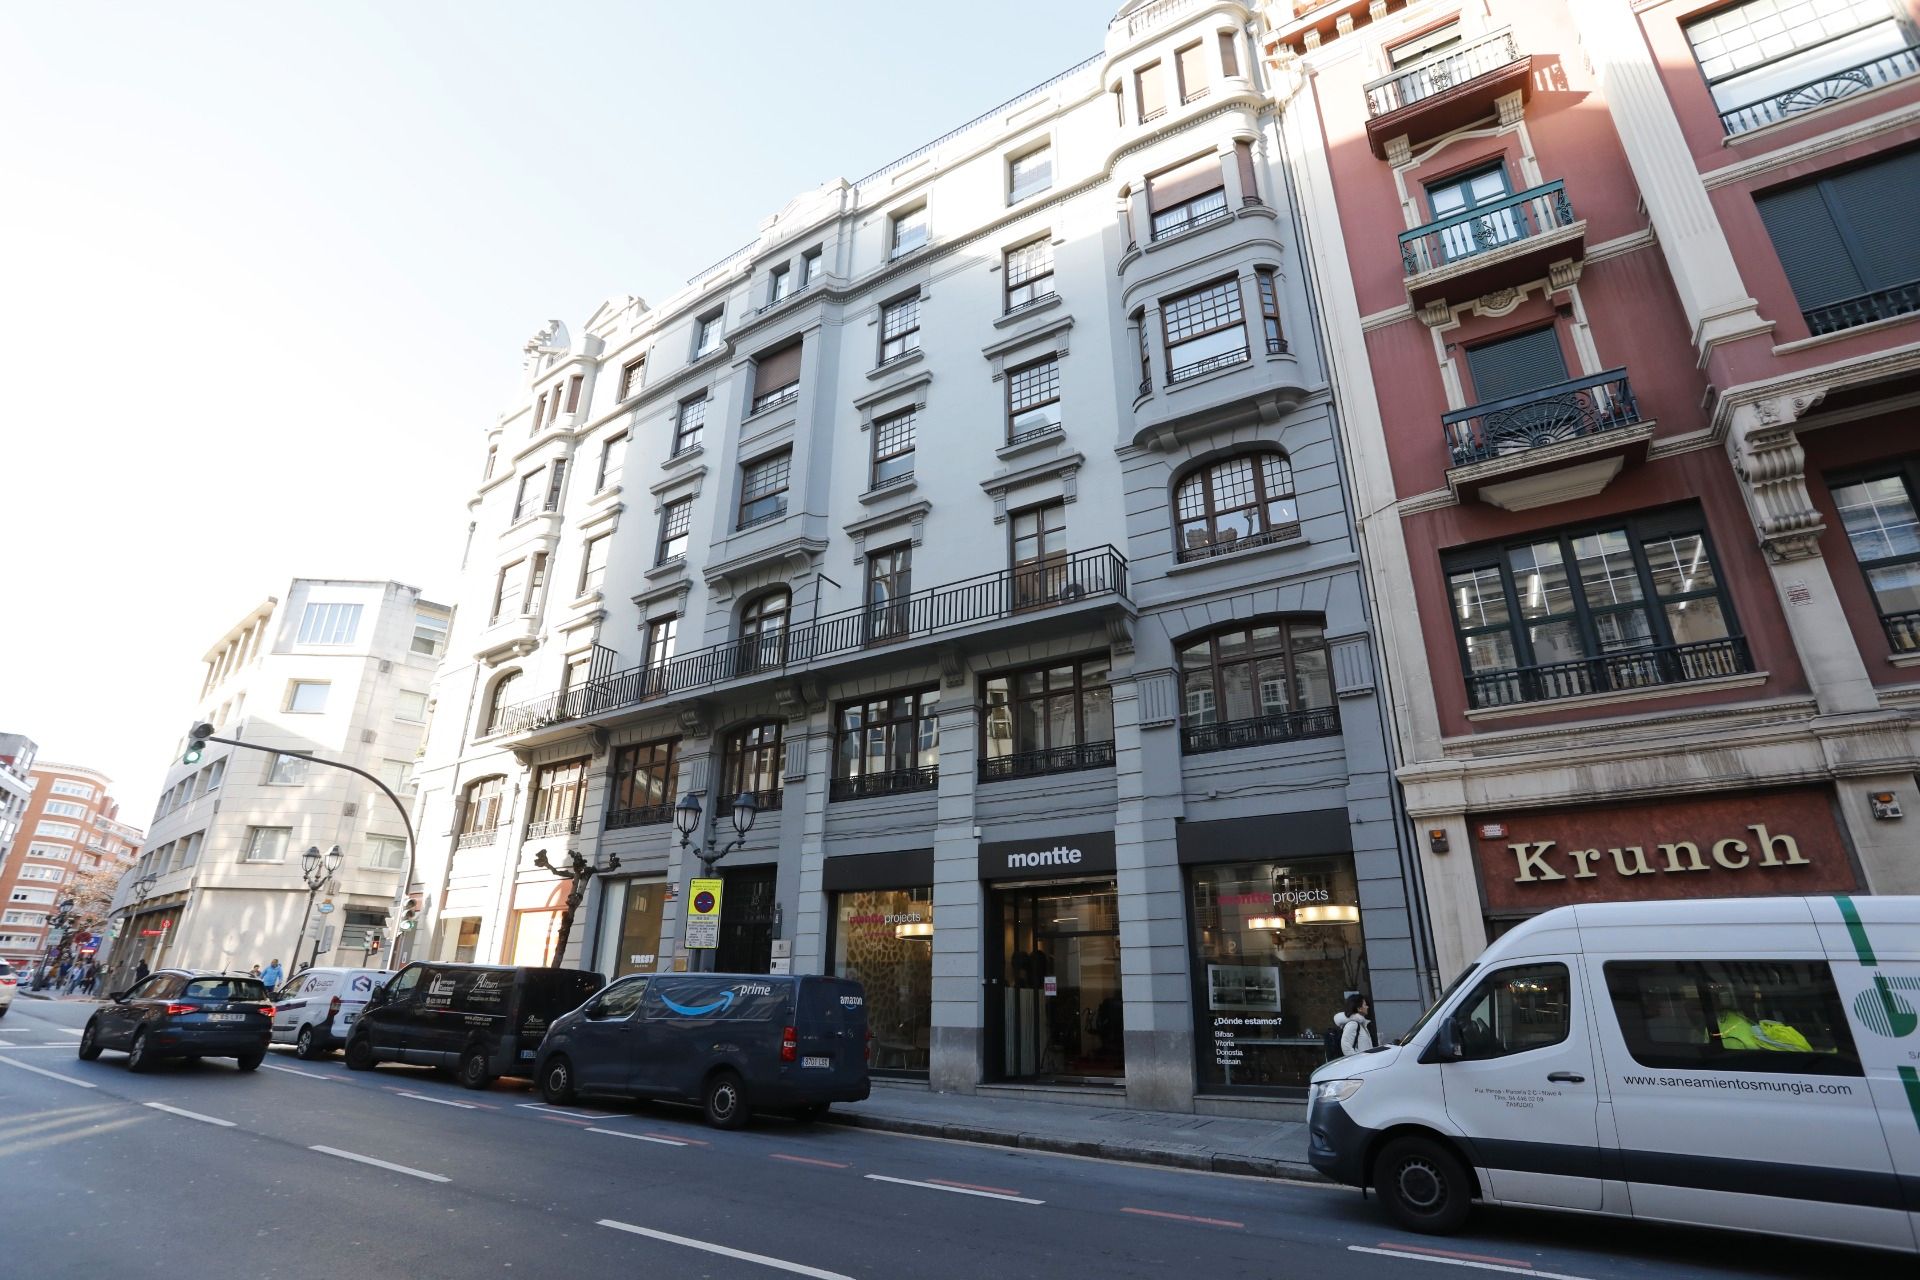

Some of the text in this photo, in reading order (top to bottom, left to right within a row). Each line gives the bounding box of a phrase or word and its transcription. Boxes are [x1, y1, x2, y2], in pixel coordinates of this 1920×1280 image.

[1007, 846, 1082, 868] montte
[1507, 823, 1810, 883] Krunch
[740, 983, 771, 996] prime
[840, 996, 863, 1005] amazon
[1214, 1017, 1282, 1026] ¿Dónde estamos?
[1623, 1075, 1852, 1096] www.saneamientosmungia.com
